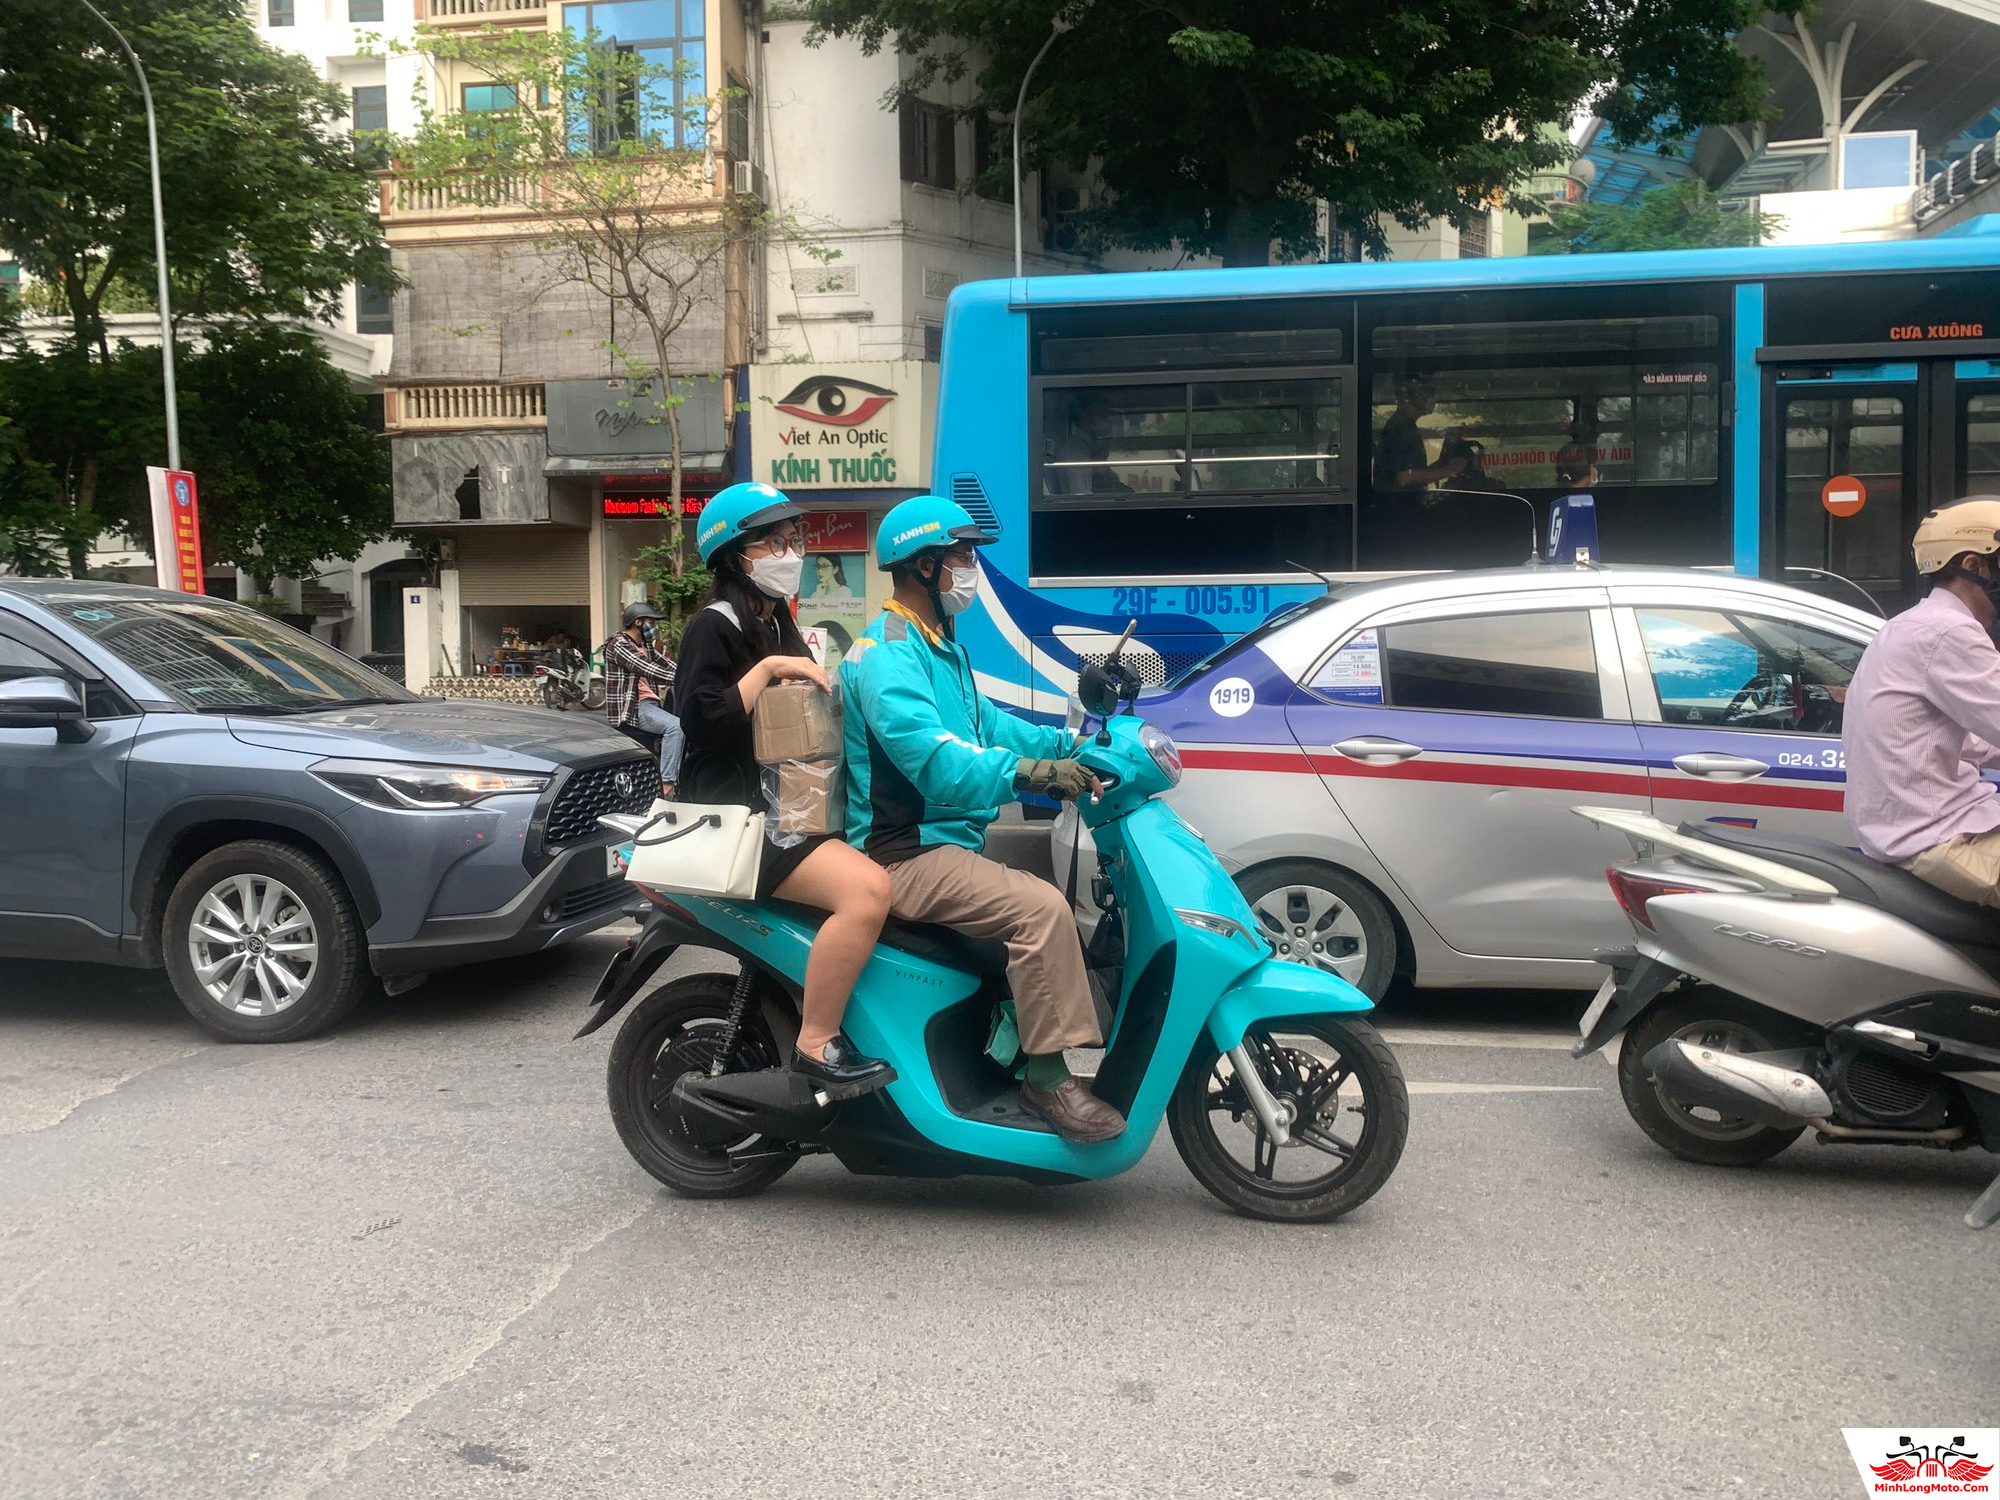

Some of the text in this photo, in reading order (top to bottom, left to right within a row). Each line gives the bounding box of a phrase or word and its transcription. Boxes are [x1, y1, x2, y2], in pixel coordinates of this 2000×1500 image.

[818, 429, 840, 445] An
[846, 428, 888, 448] Optic
[771, 448, 897, 483] KÍNH THUỐC
[795, 513, 854, 545] Ray-Ban
[1112, 587, 1158, 616] 29F
[1184, 584, 1270, 615] 005.91
[1214, 687, 1250, 704] 1919
[1713, 923, 1827, 957] LEAD
[895, 969, 944, 988] VINFAST
